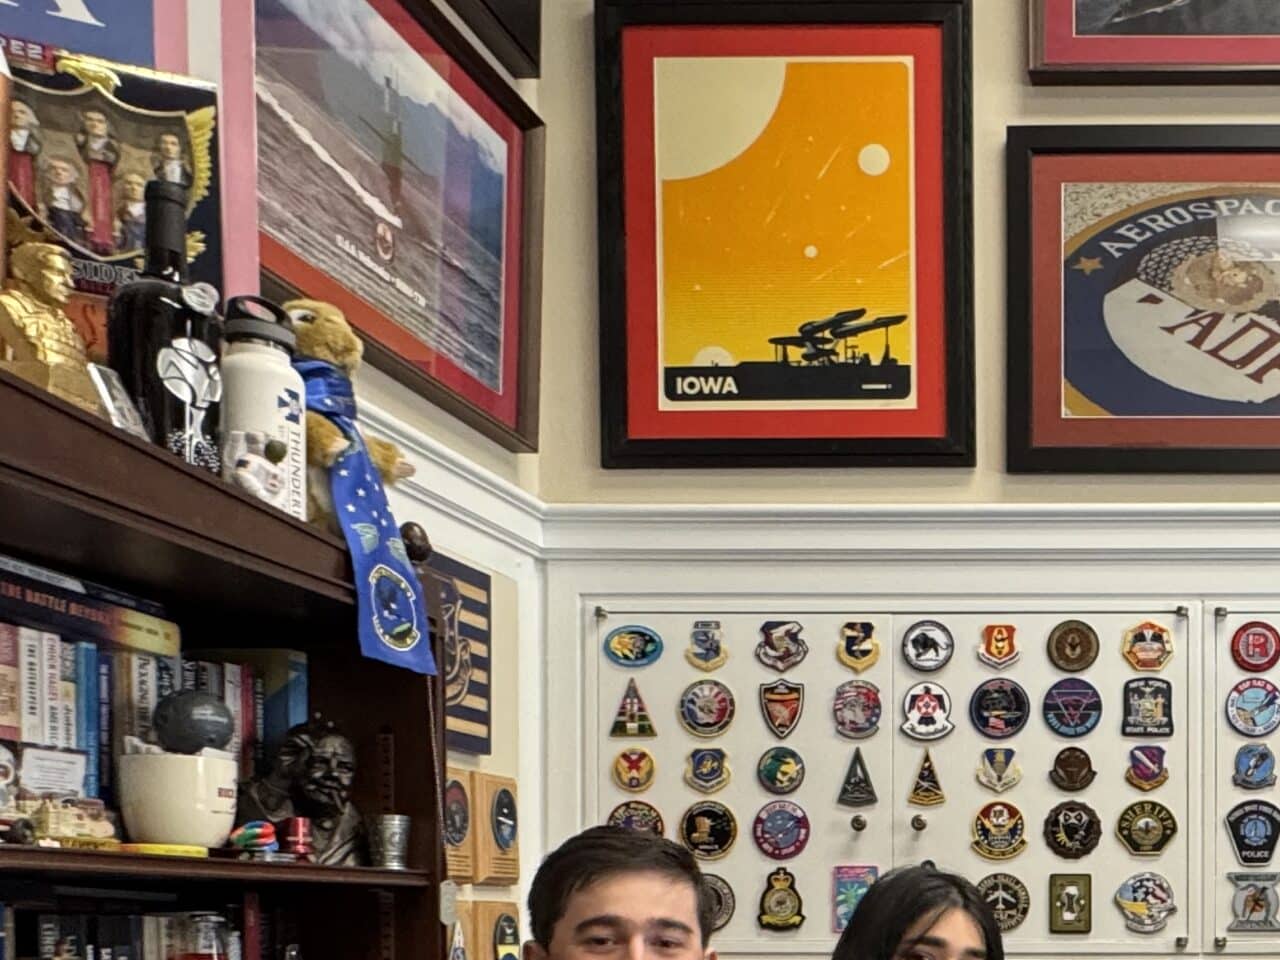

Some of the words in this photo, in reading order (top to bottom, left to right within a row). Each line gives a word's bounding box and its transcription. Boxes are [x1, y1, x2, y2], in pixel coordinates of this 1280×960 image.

[675, 376, 739, 395] IOWA
[1247, 633, 1269, 658] R
[1120, 803, 1174, 828] SHERIFF
[1241, 850, 1270, 858] POLICE
